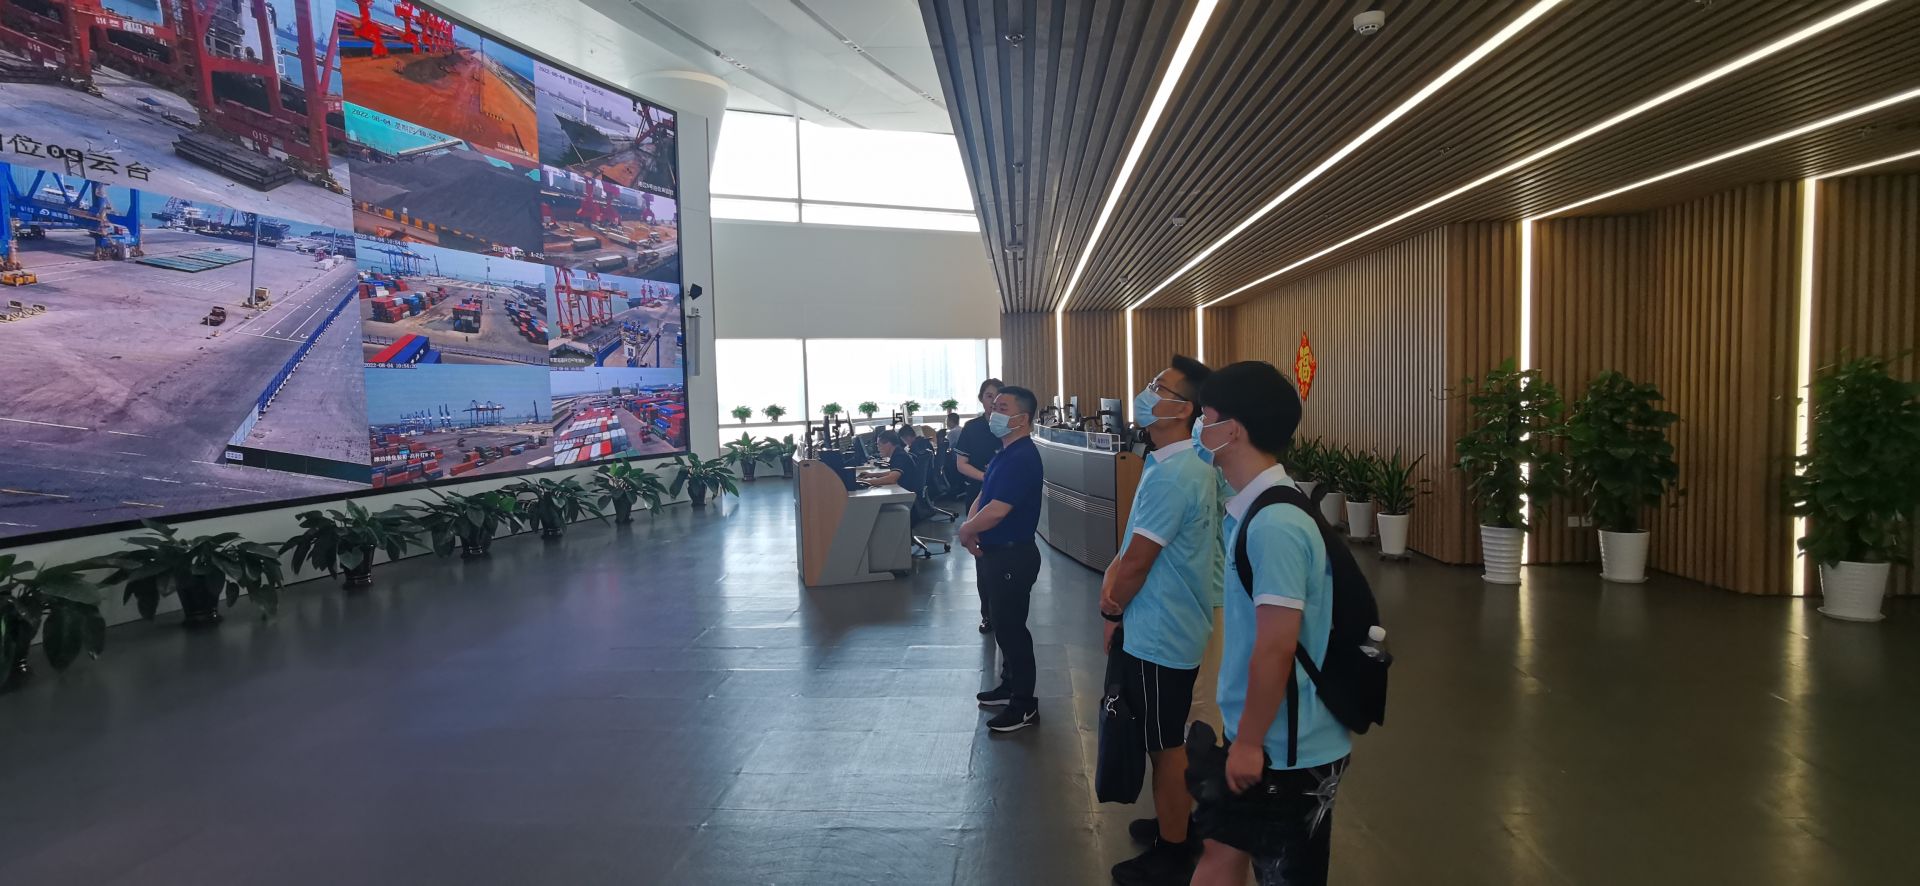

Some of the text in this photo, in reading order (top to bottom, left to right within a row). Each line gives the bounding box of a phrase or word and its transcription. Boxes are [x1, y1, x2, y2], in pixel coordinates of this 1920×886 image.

[252, 130, 269, 143] 015
[0, 133, 152, 182] 位09云台
